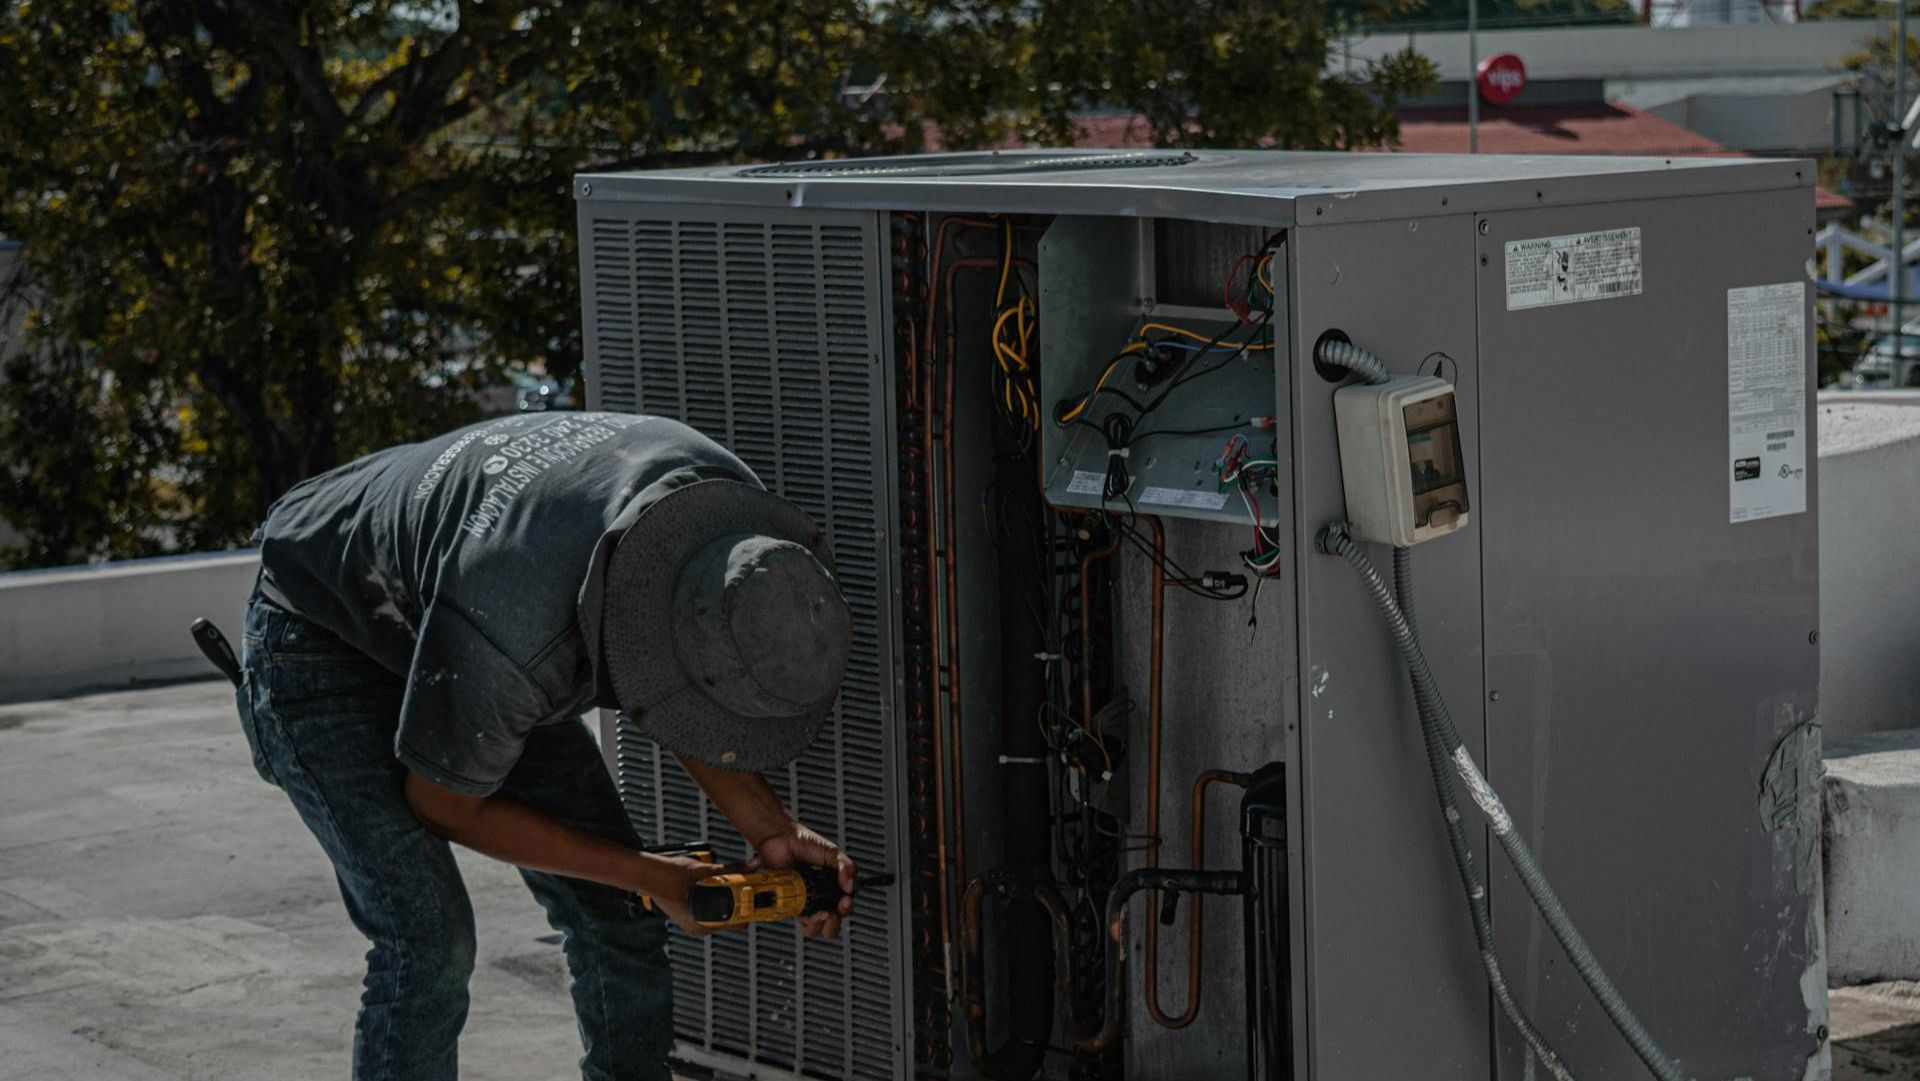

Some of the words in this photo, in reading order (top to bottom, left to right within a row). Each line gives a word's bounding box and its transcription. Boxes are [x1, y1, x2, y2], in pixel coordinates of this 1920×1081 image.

[1487, 67, 1521, 93] vips
[1520, 241, 1551, 250] WARNING
[542, 419, 583, 438] 240
[501, 433, 551, 458] 3230
[463, 459, 543, 538] INSTALACIÓN
